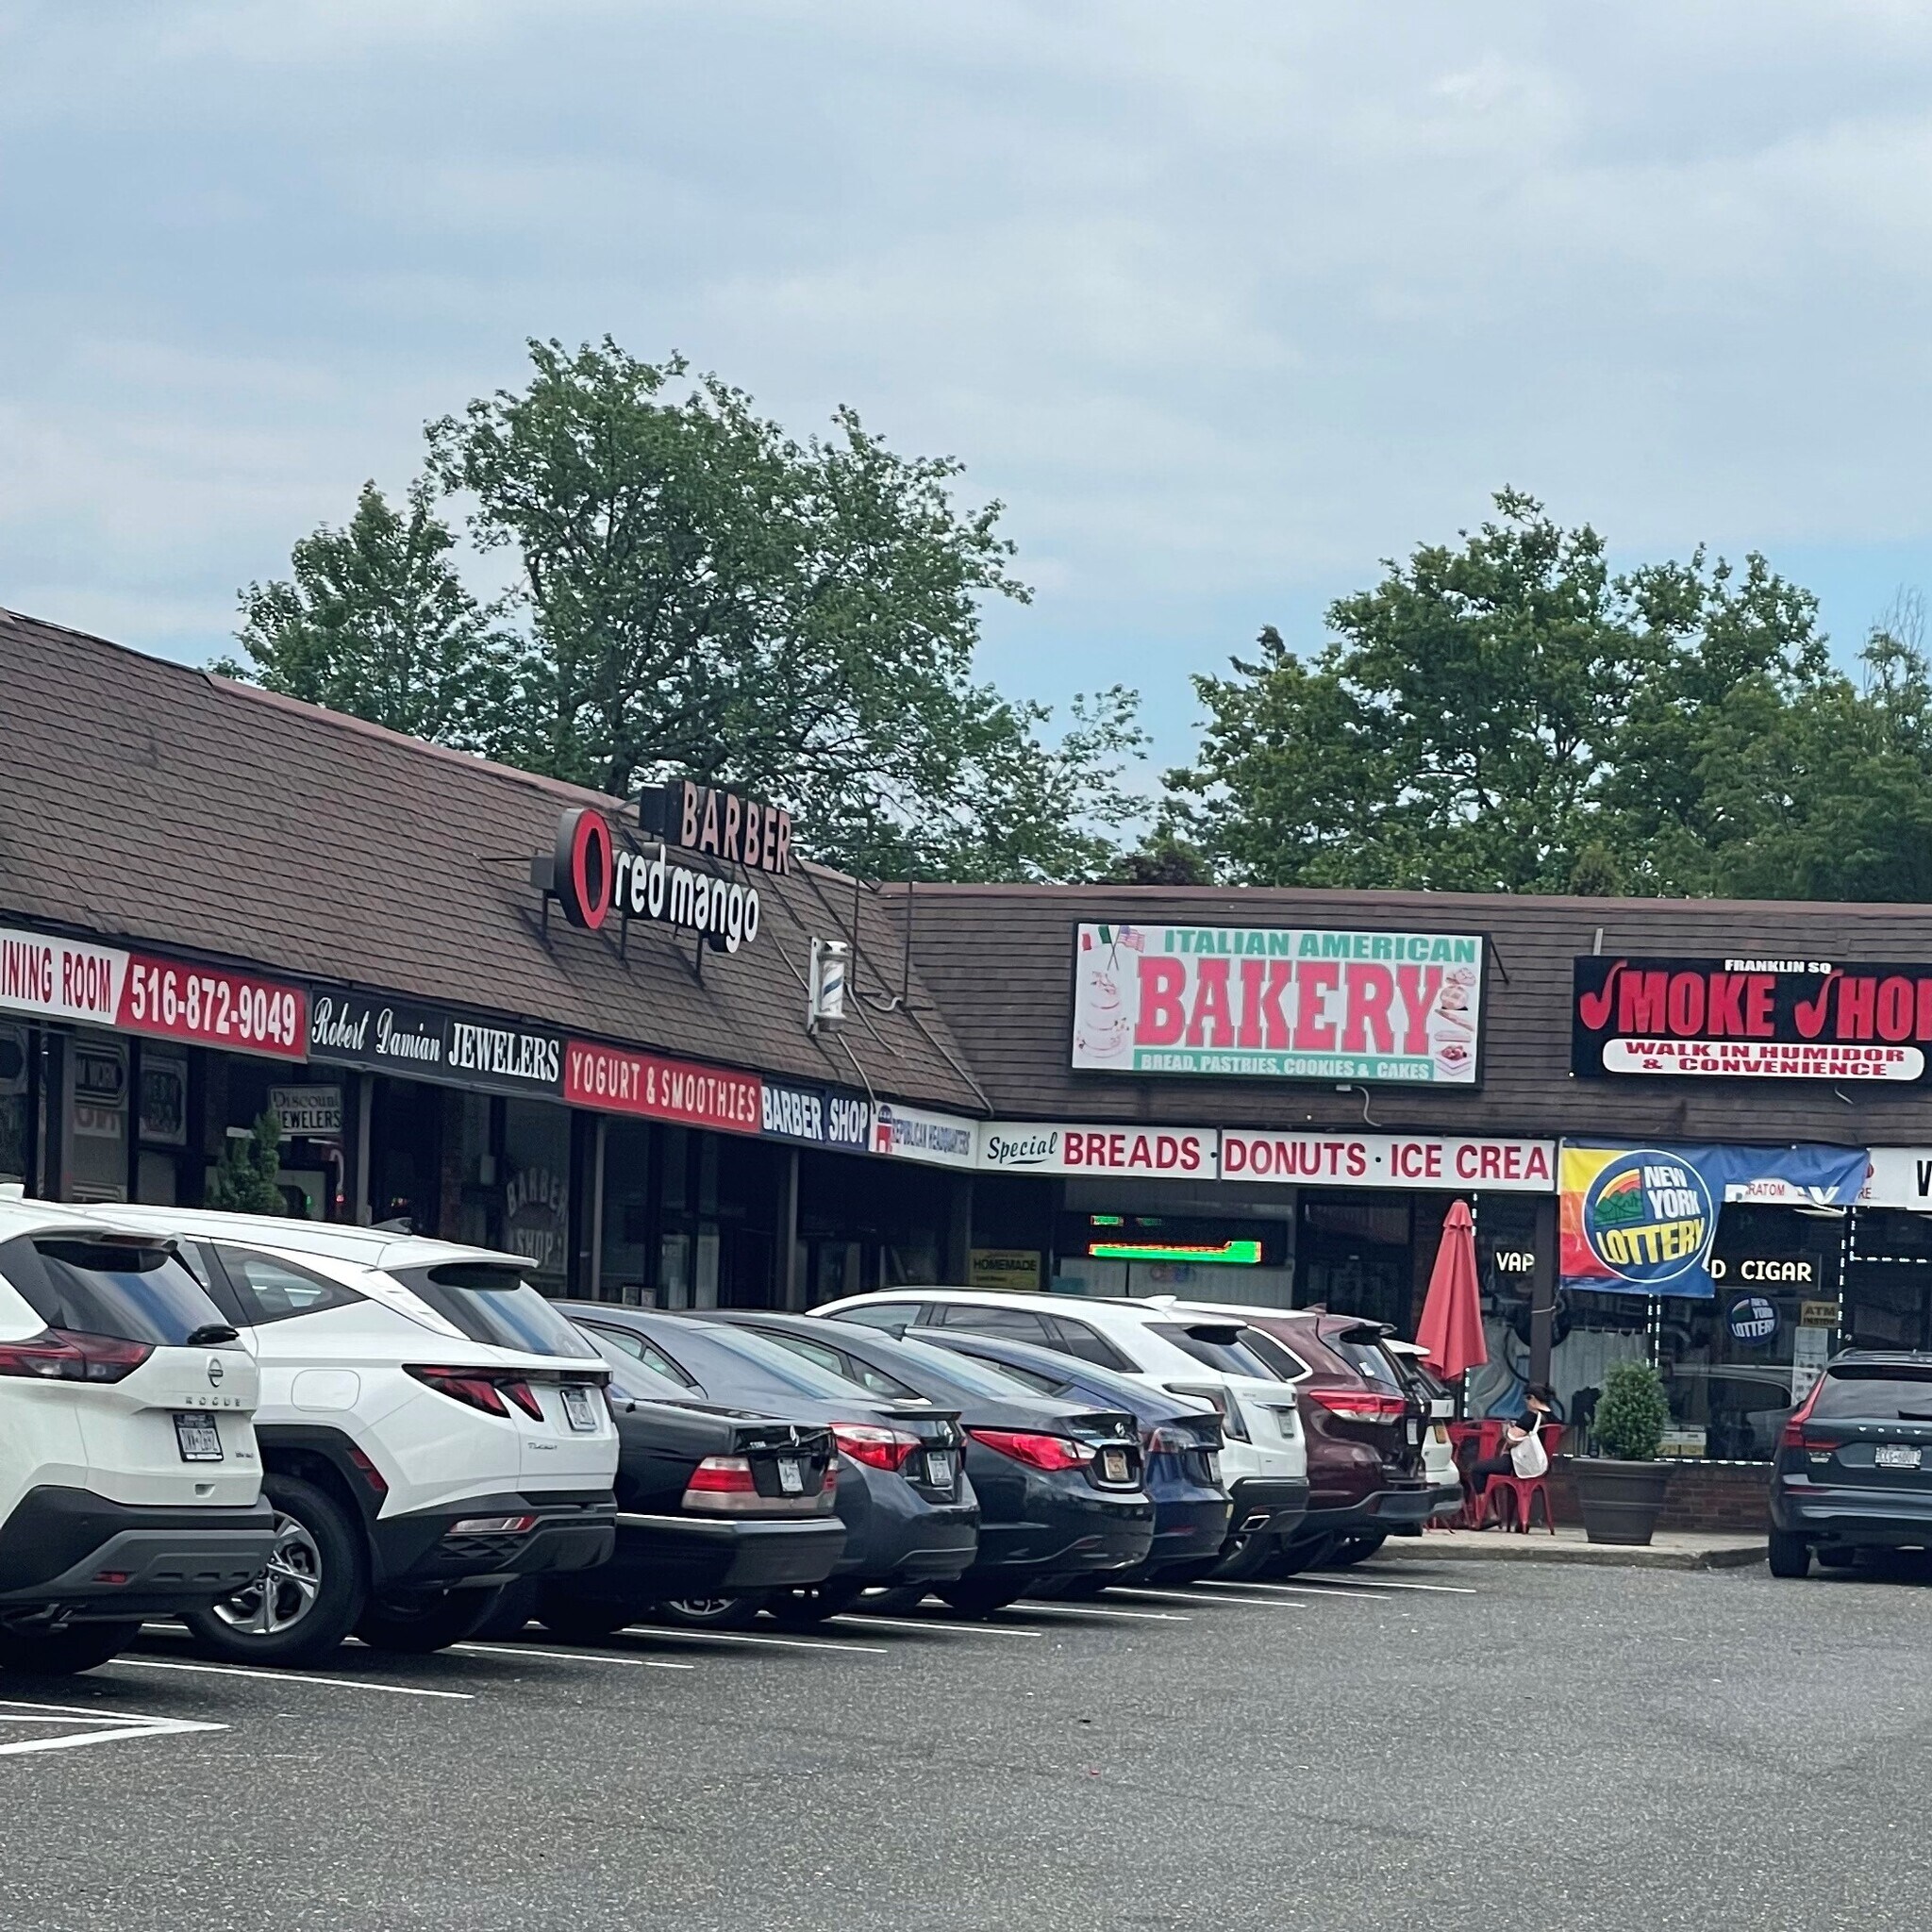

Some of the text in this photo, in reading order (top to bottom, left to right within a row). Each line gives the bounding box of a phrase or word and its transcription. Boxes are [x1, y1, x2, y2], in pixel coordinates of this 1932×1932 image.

[681, 780, 792, 875] BARBER
[614, 842, 760, 954] red mango
[1164, 929, 1475, 963] ITALIAN AMERICAN
[0, 939, 111, 1013] INING ROOM
[1724, 958, 1832, 974] FRANKLIN SQ
[130, 964, 296, 1047] 516-872-9049
[1133, 956, 1444, 1056] BAKERY
[311, 996, 560, 1083] Robert Damian JEWELERS
[1624, 1041, 1905, 1062] WALK IN HUMIDOR
[1283, 1058, 1355, 1076] COOKIES
[1357, 1063, 1370, 1077] &
[1376, 1061, 1429, 1079] CAKES
[1642, 1058, 1888, 1076] & CONVENIENCE
[572, 1050, 756, 1123] YOGURT & SMOOTHIES
[761, 1085, 869, 1143] BARBER SHOP
[987, 1131, 1550, 1180] Special BREADS DONUTS ICE CREA
[1644, 1166, 1688, 1188] NEW
[1746, 1183, 1785, 1196] RATOM
[1647, 1189, 1702, 1220] YORK
[1595, 1217, 1706, 1265] LOTTERY
[974, 1258, 1037, 1271] HOMEMADE
[1740, 1260, 1812, 1282] CIGAR
[1805, 1307, 1836, 1316] ATM
